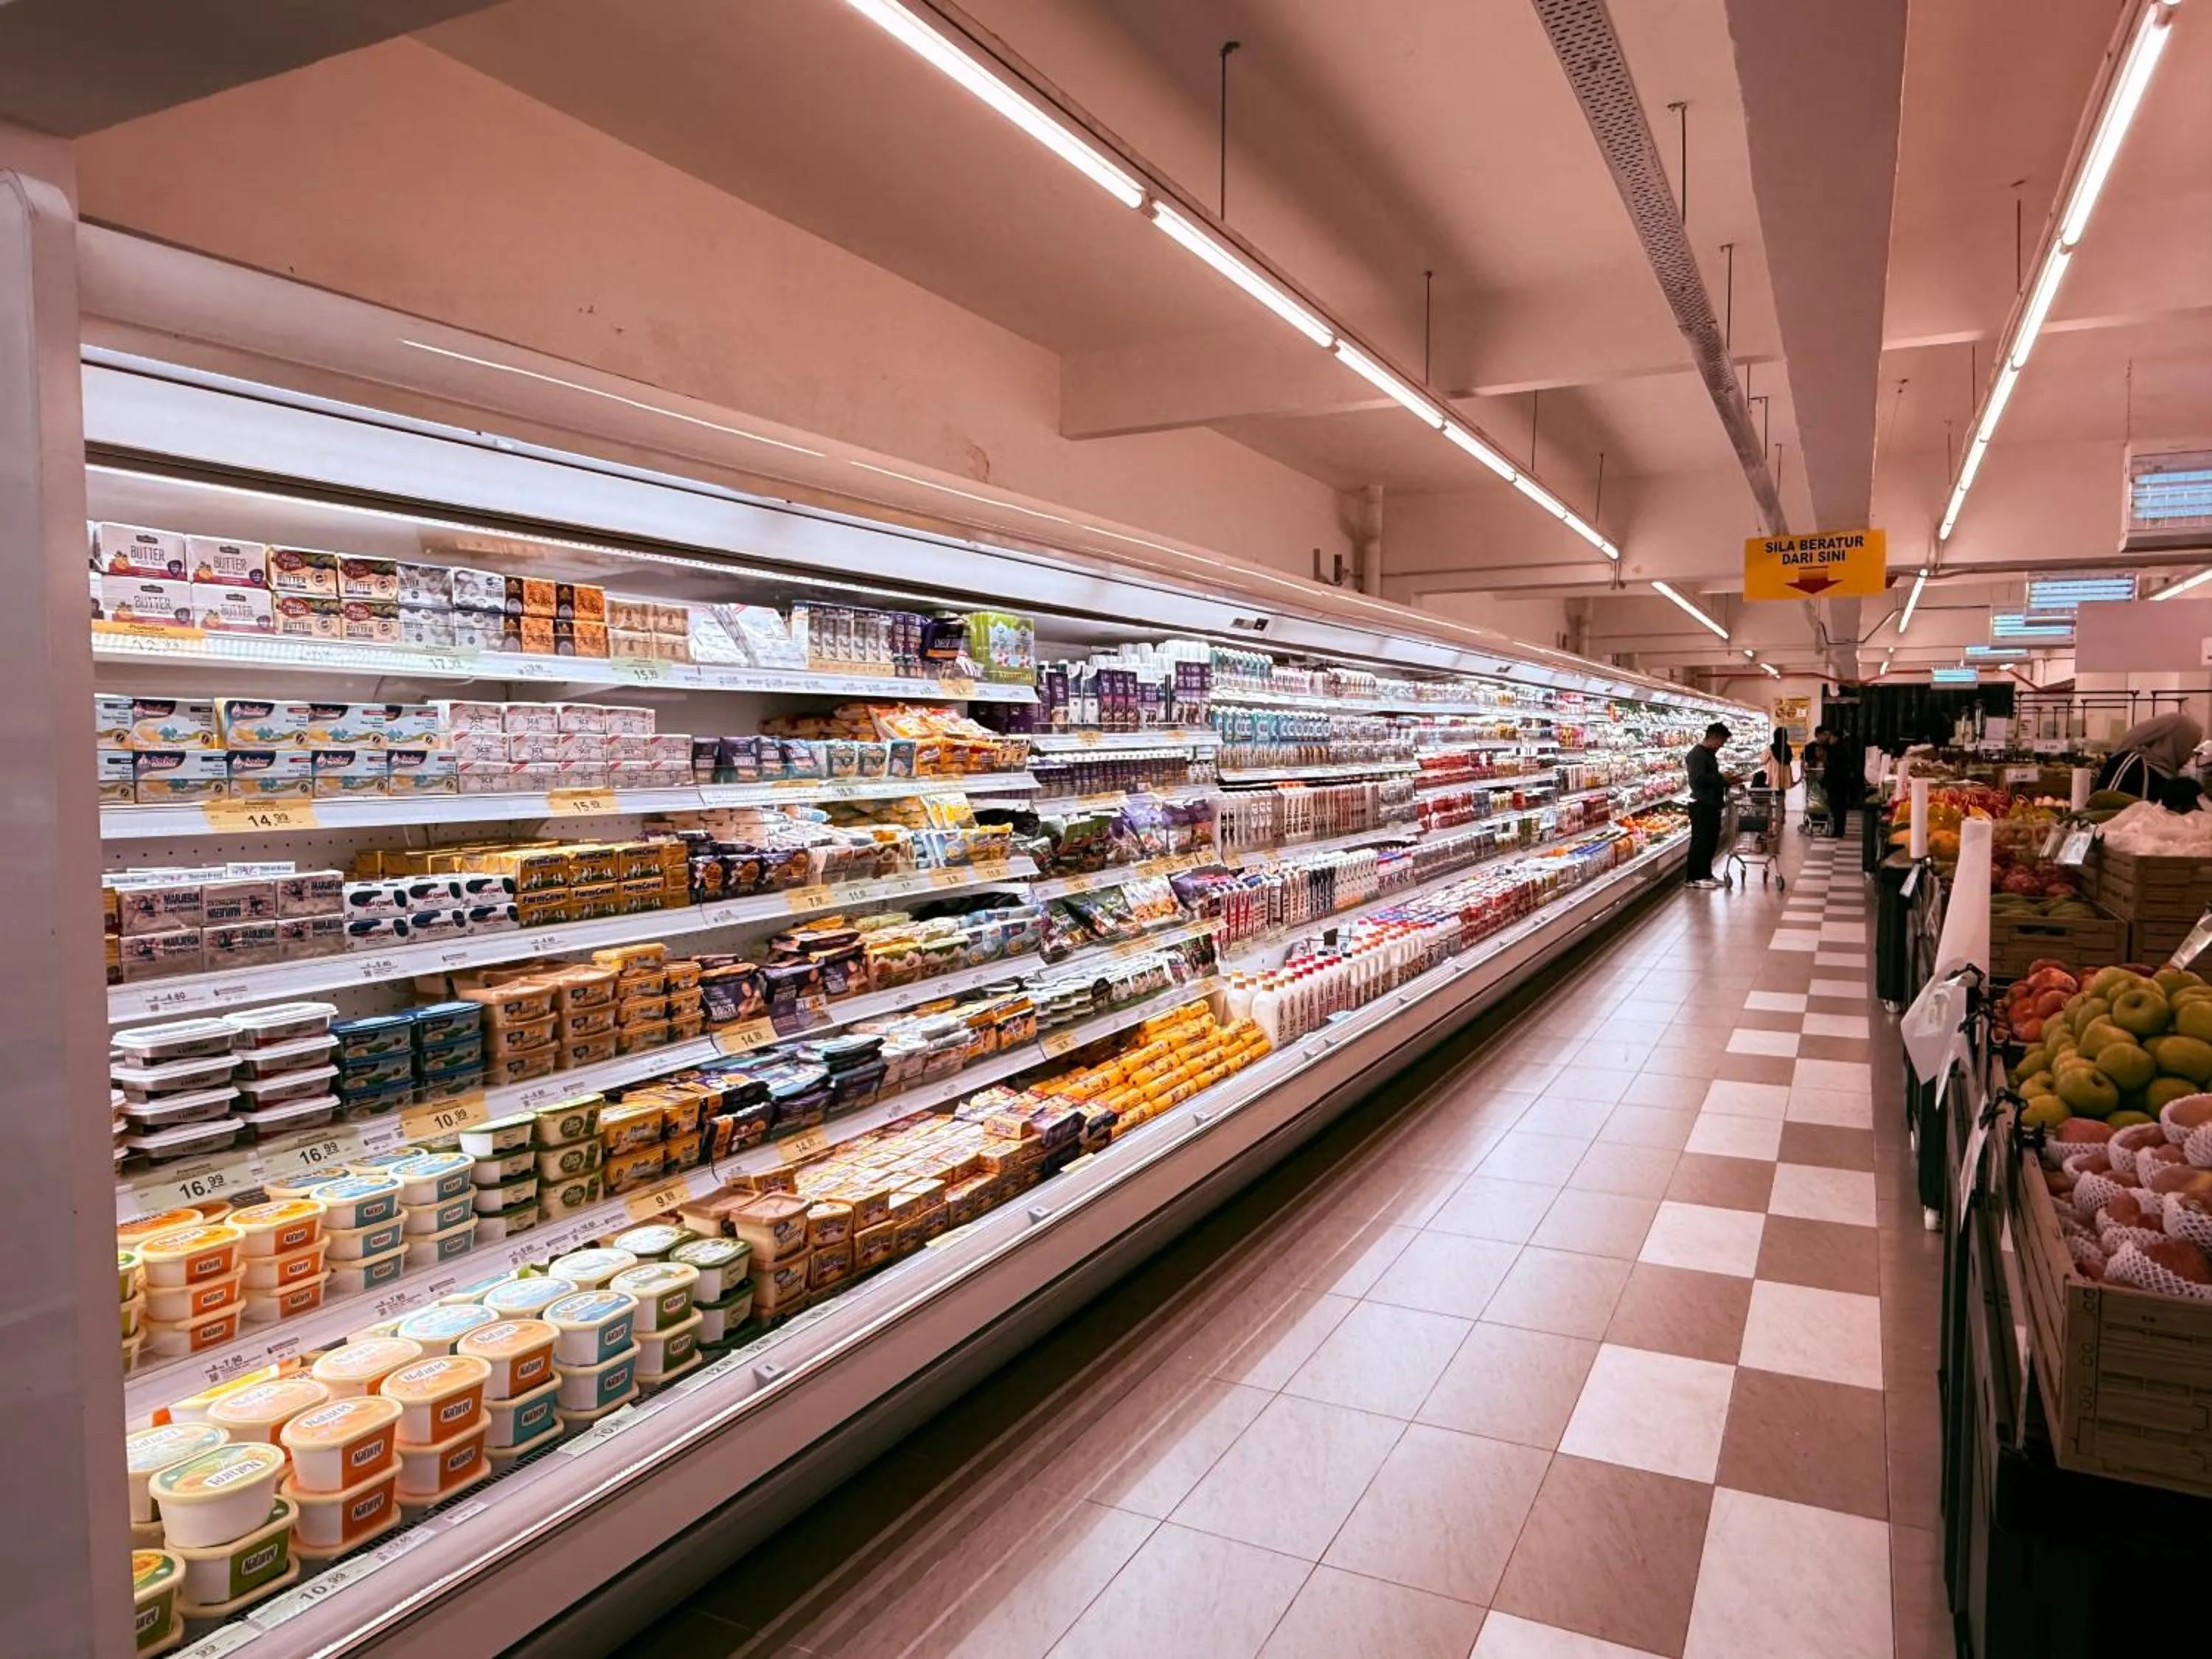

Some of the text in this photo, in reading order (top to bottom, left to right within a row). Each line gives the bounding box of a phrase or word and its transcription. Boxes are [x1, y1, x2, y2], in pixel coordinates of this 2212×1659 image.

[131, 545, 164, 562] BUTTER
[1764, 535, 1864, 553] SILA BERATUR
[213, 555, 247, 571] BUTTER
[1782, 550, 1846, 565] DARI SINI
[434, 1108, 467, 1129] 10.99
[299, 1142, 338, 1164] 16.99
[179, 1174, 224, 1200] 16.99
[243, 1546, 277, 1571] Naturel
[300, 1572, 347, 1601] 10.99
